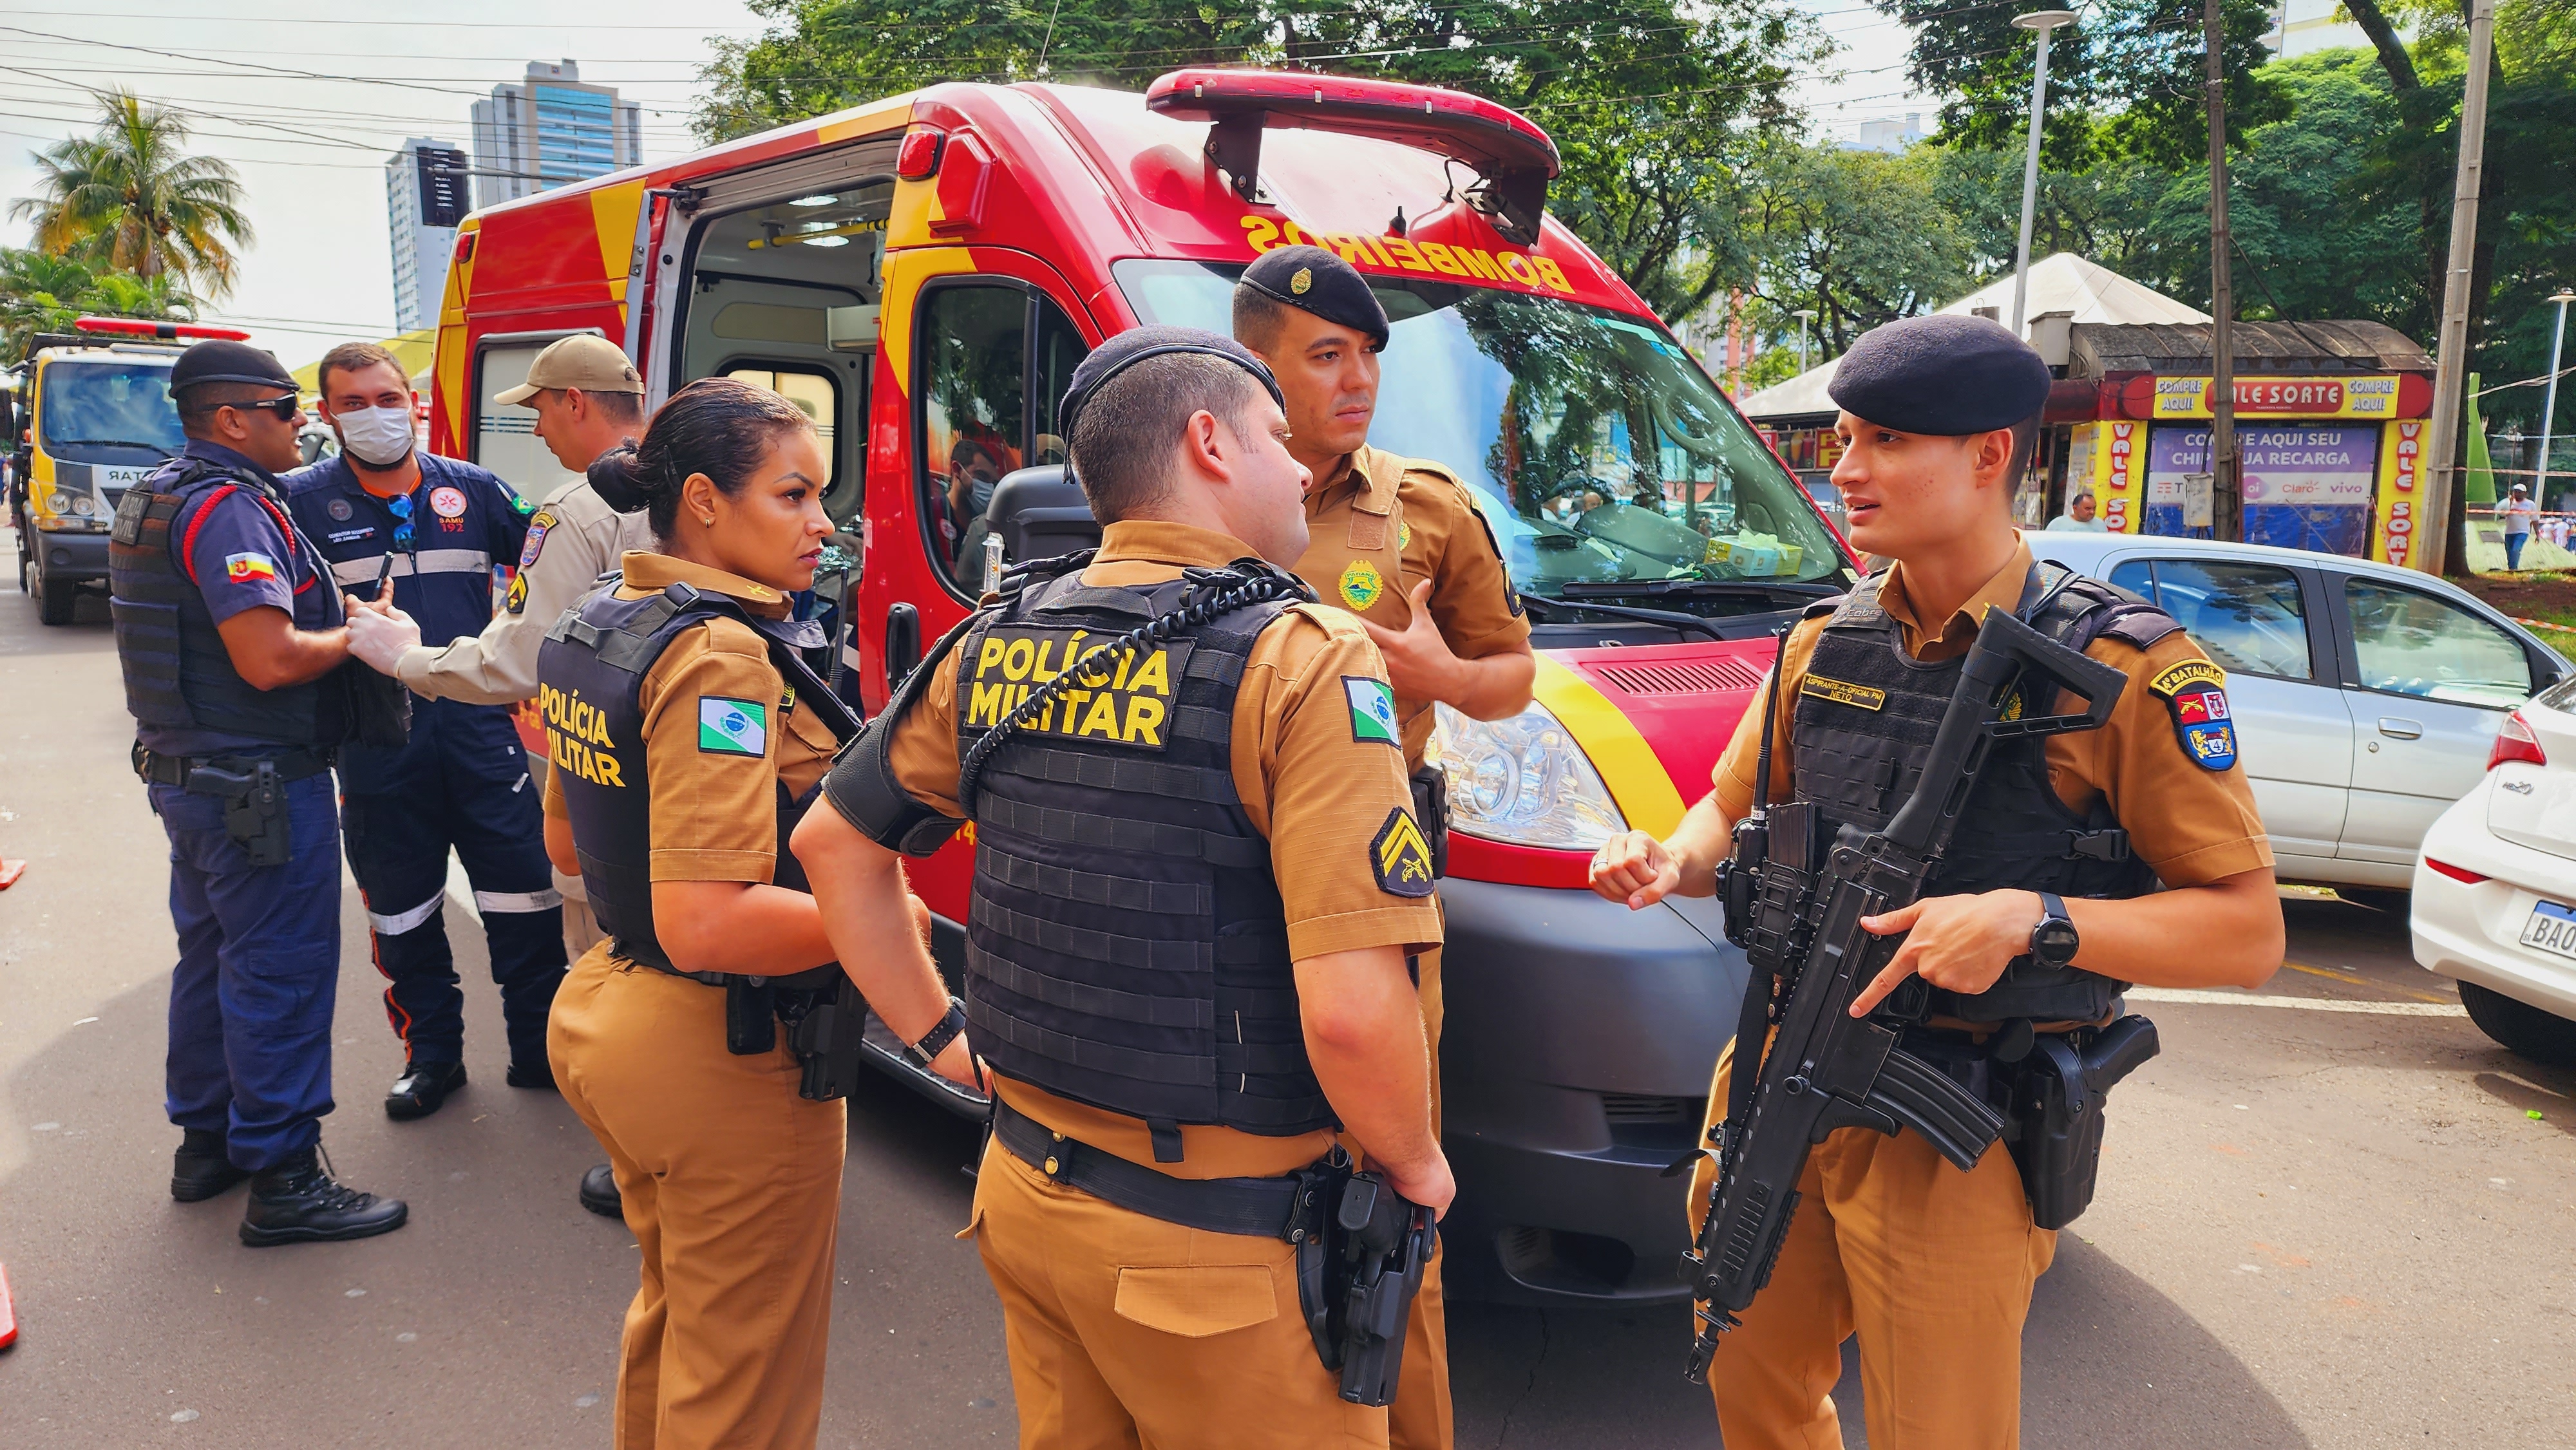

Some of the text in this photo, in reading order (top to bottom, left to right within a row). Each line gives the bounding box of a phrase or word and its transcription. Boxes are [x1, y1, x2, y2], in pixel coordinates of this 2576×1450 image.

[2157, 381, 2202, 394] COMPRE
[2348, 380, 2395, 394] COMPRE
[2269, 386, 2338, 404] SORTE
[2161, 397, 2194, 411] AQUI!
[2352, 397, 2386, 411] AQUI!
[2259, 433, 2304, 449] AQUI
[2307, 433, 2342, 446] SEU
[2110, 423, 2134, 487] VALE
[2242, 452, 2264, 466] UA
[2269, 452, 2351, 466] RECARGA
[2398, 423, 2420, 488] VALE
[2282, 484, 2314, 493] Claro
[2330, 484, 2363, 494] vivo
[439, 523, 465, 532] 192
[2387, 502, 2412, 567] SORT
[976, 630, 1170, 696] POLÍCIA
[2170, 665, 2222, 684] BATALHÃO
[1829, 690, 1853, 702] NETO
[1871, 692, 1882, 700] PM
[540, 682, 616, 748] POLÍCIA
[968, 681, 1165, 746] MILITAR
